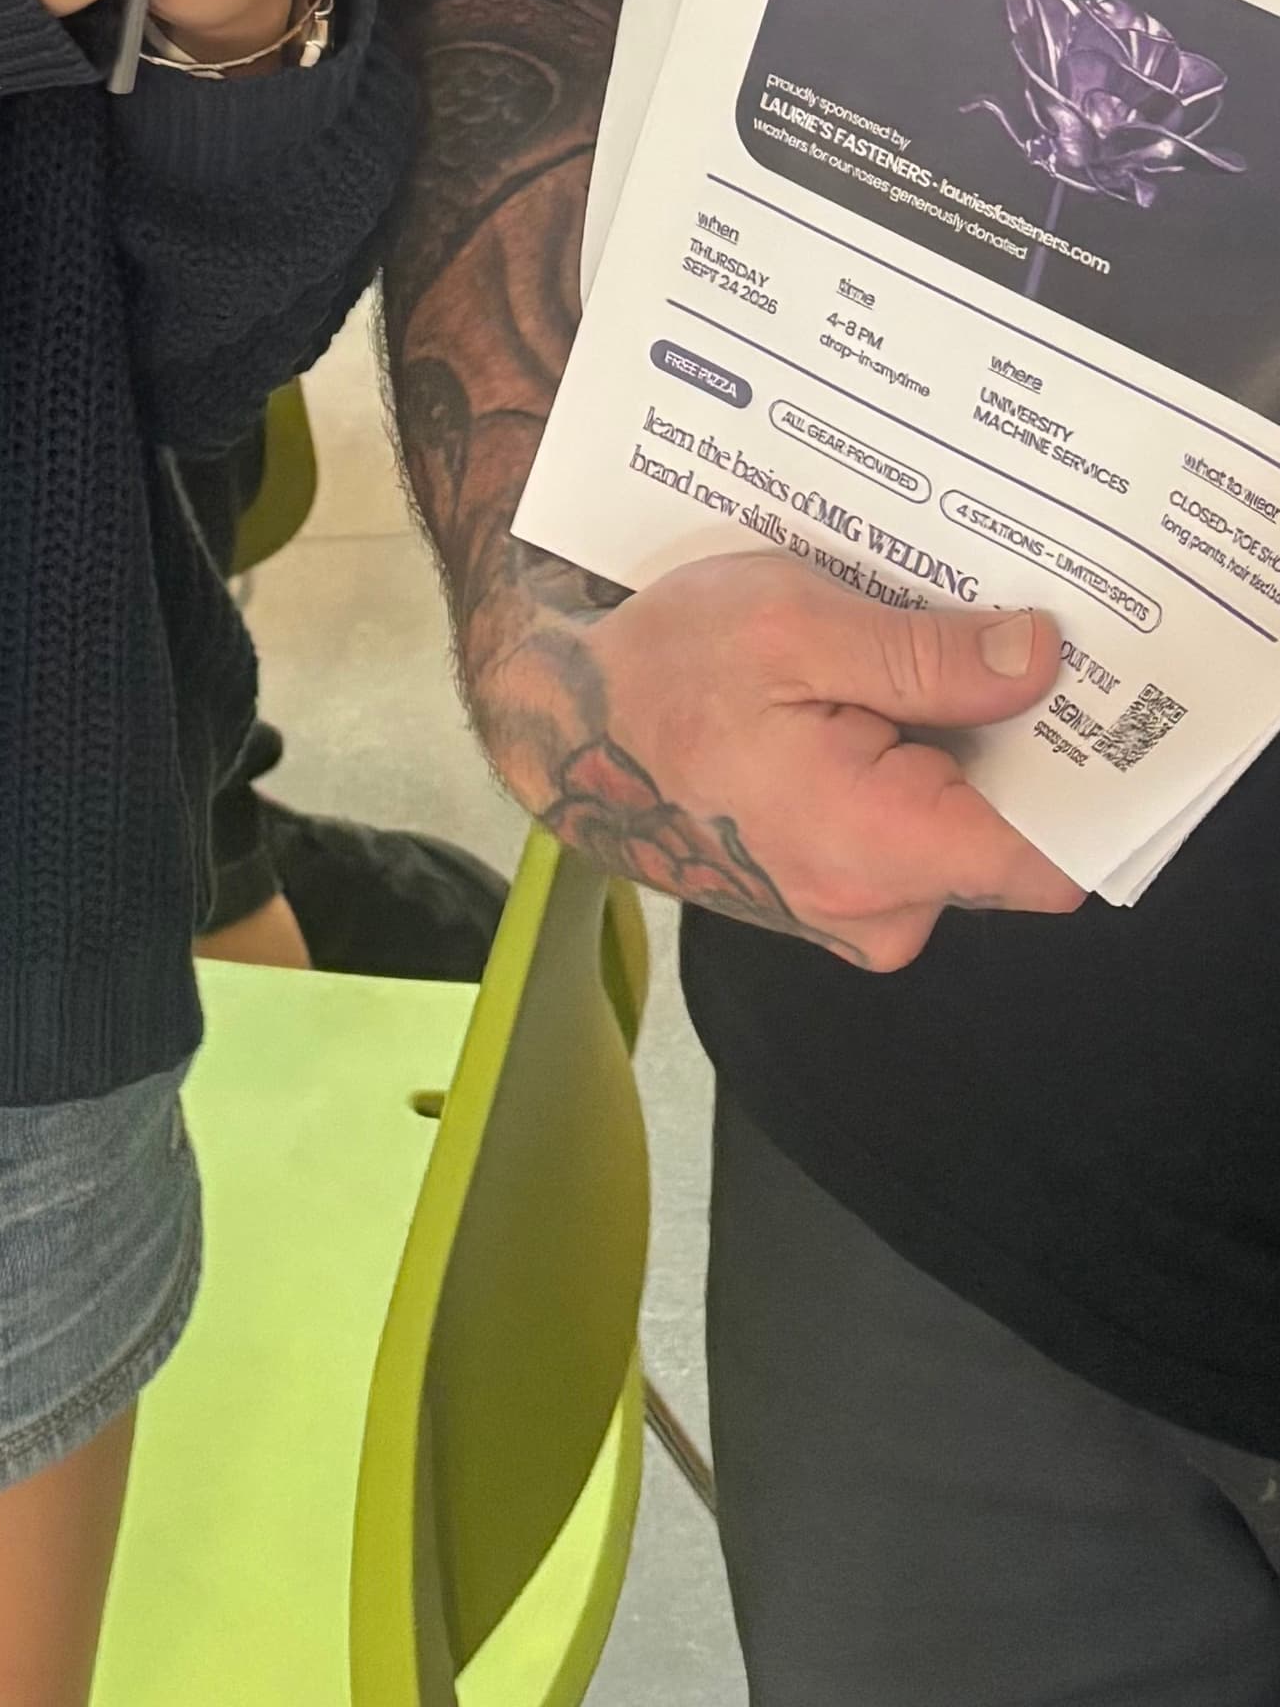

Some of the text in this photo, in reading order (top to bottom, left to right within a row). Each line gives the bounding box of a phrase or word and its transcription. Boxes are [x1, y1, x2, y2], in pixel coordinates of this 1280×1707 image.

[766, 73, 912, 152] proudly sponsored by
[753, 117, 1027, 260] washers for our roses generously donated
[759, 92, 1111, 275] LAURIE'S FASTENERS lauriesfasteners.com
[697, 211, 740, 243] when
[682, 256, 778, 315] SEPT 24 2026
[689, 238, 770, 288] THURSDAY
[838, 277, 876, 307] time
[819, 334, 931, 397] drop-in anytime
[857, 327, 885, 351] PM
[664, 350, 738, 399] FREE PIZZA
[990, 355, 1043, 390] where
[979, 386, 1073, 443] UNIVERSITY
[781, 409, 919, 492] ALL GEAR PROVIDED
[972, 405, 1130, 495] MACHINE SERVICES
[1184, 452, 1226, 487] what
[1226, 475, 1242, 496] to
[629, 444, 692, 496] brand
[694, 481, 741, 518] new
[738, 504, 787, 547] skills
[814, 547, 865, 591] work
[642, 405, 979, 605] learn the basics of MIG WELDING
[1169, 490, 1260, 557] CLOSED-TOE
[955, 504, 968, 518] 4
[969, 510, 1045, 557] STATIONS
[1055, 553, 1110, 594] LIMITED
[1108, 585, 1150, 622] SPOTS
[1161, 513, 1191, 546] long
[1226, 557, 1251, 581] hair
